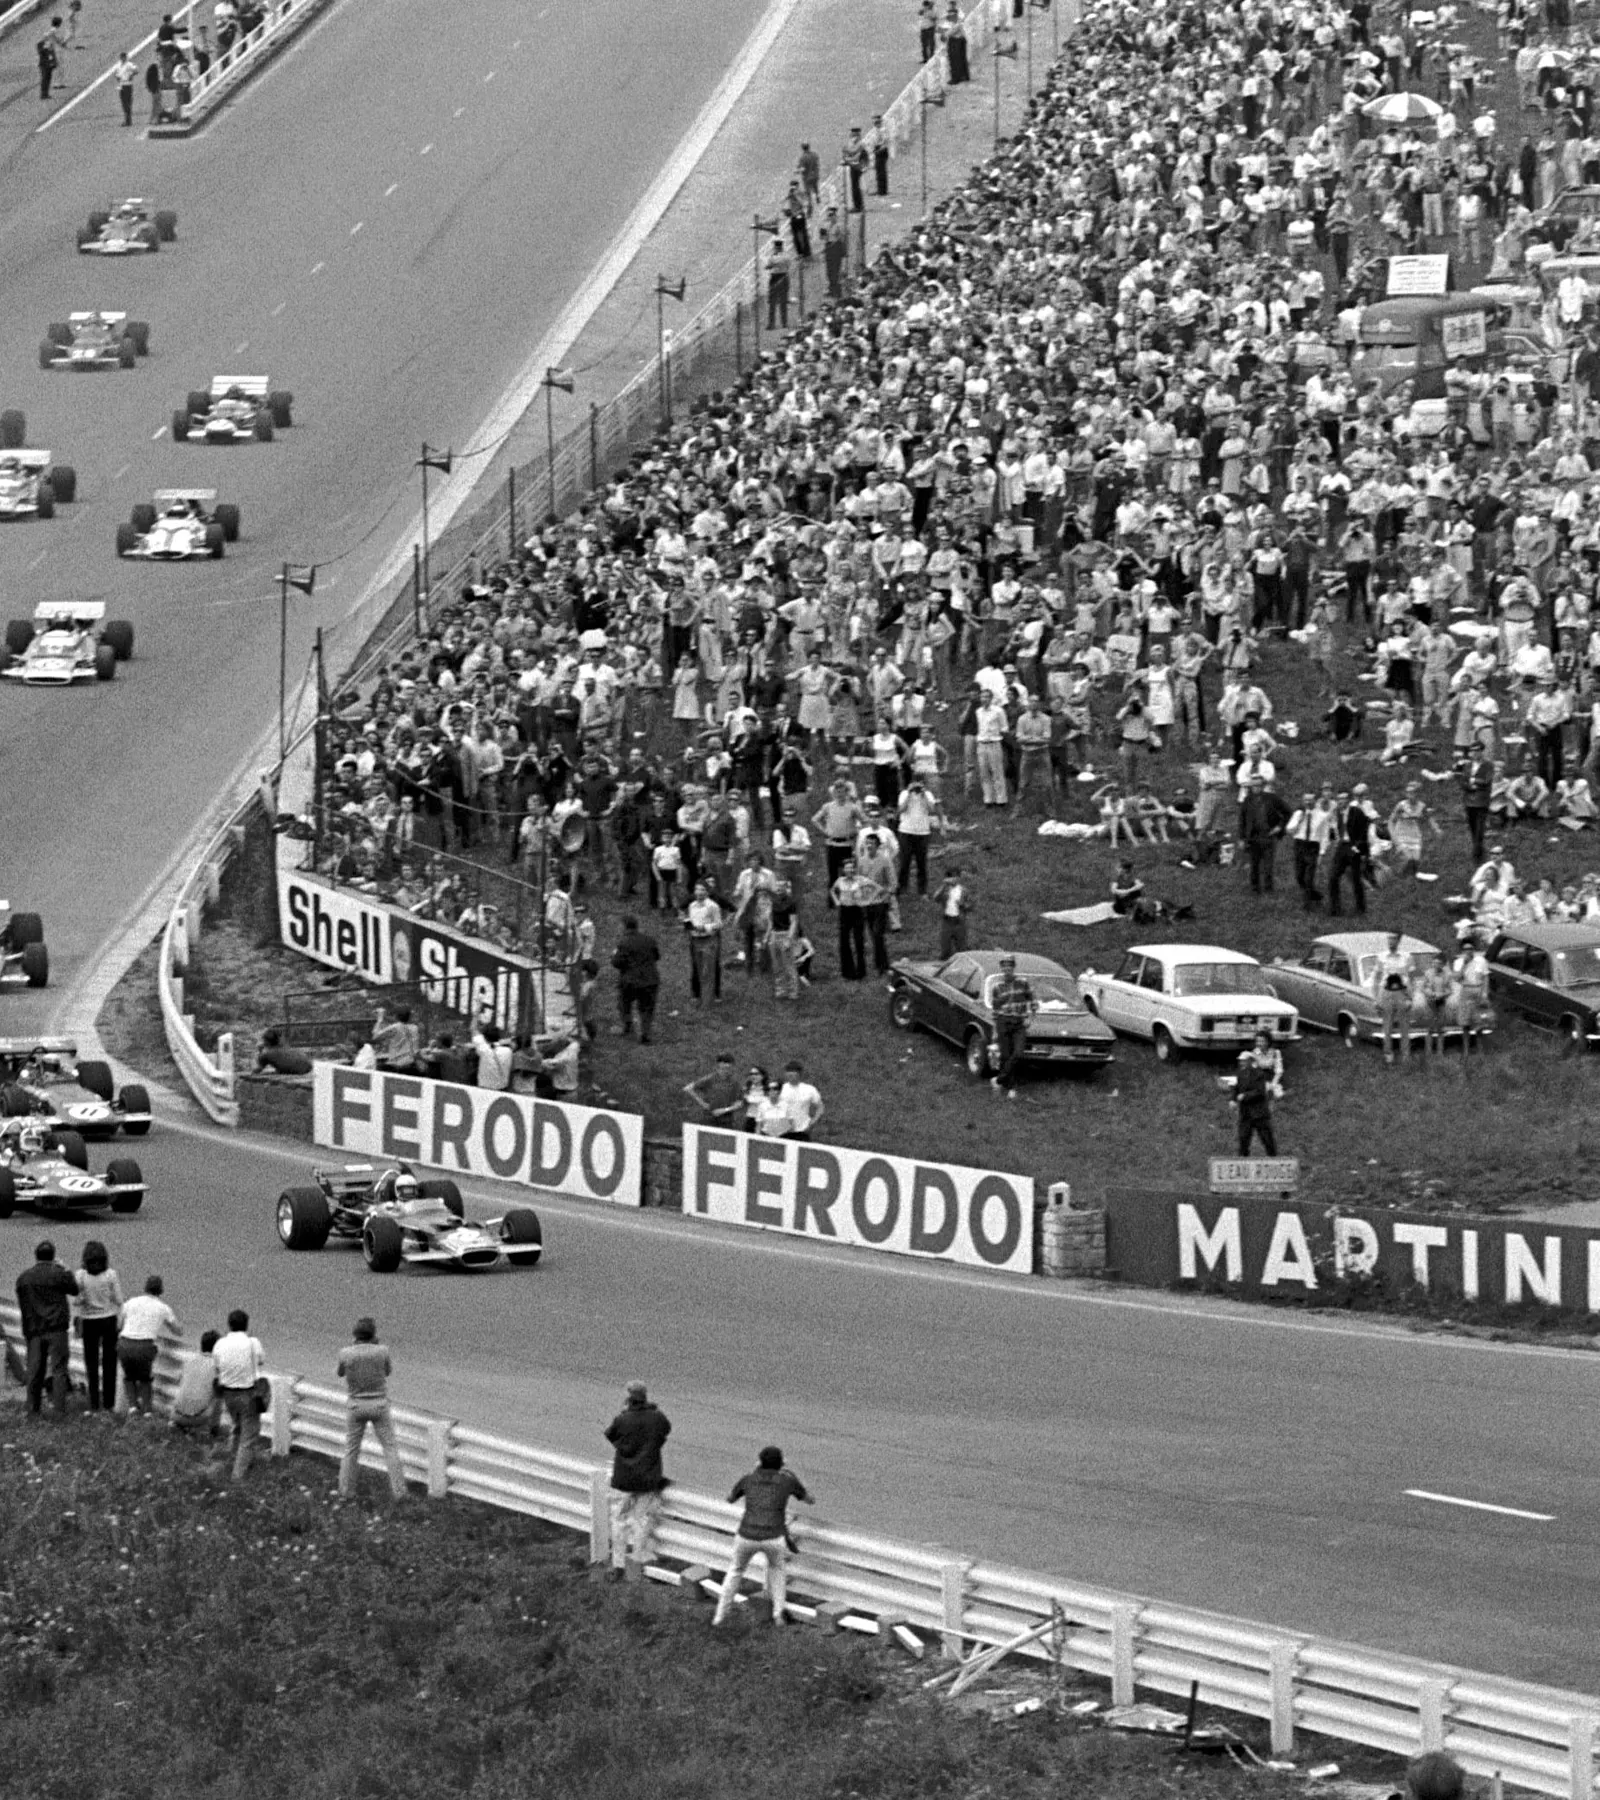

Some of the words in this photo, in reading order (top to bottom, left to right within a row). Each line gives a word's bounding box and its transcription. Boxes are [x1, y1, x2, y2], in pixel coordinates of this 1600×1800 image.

[289, 884, 381, 976] Shell
[419, 937, 520, 1036] Shell
[80, 1107, 98, 1116] 11
[333, 1068, 626, 1197] FERODO
[68, 1178, 94, 1189] 10
[696, 1129, 1022, 1265] FERODO
[1177, 1203, 1600, 1314] MARTINI
